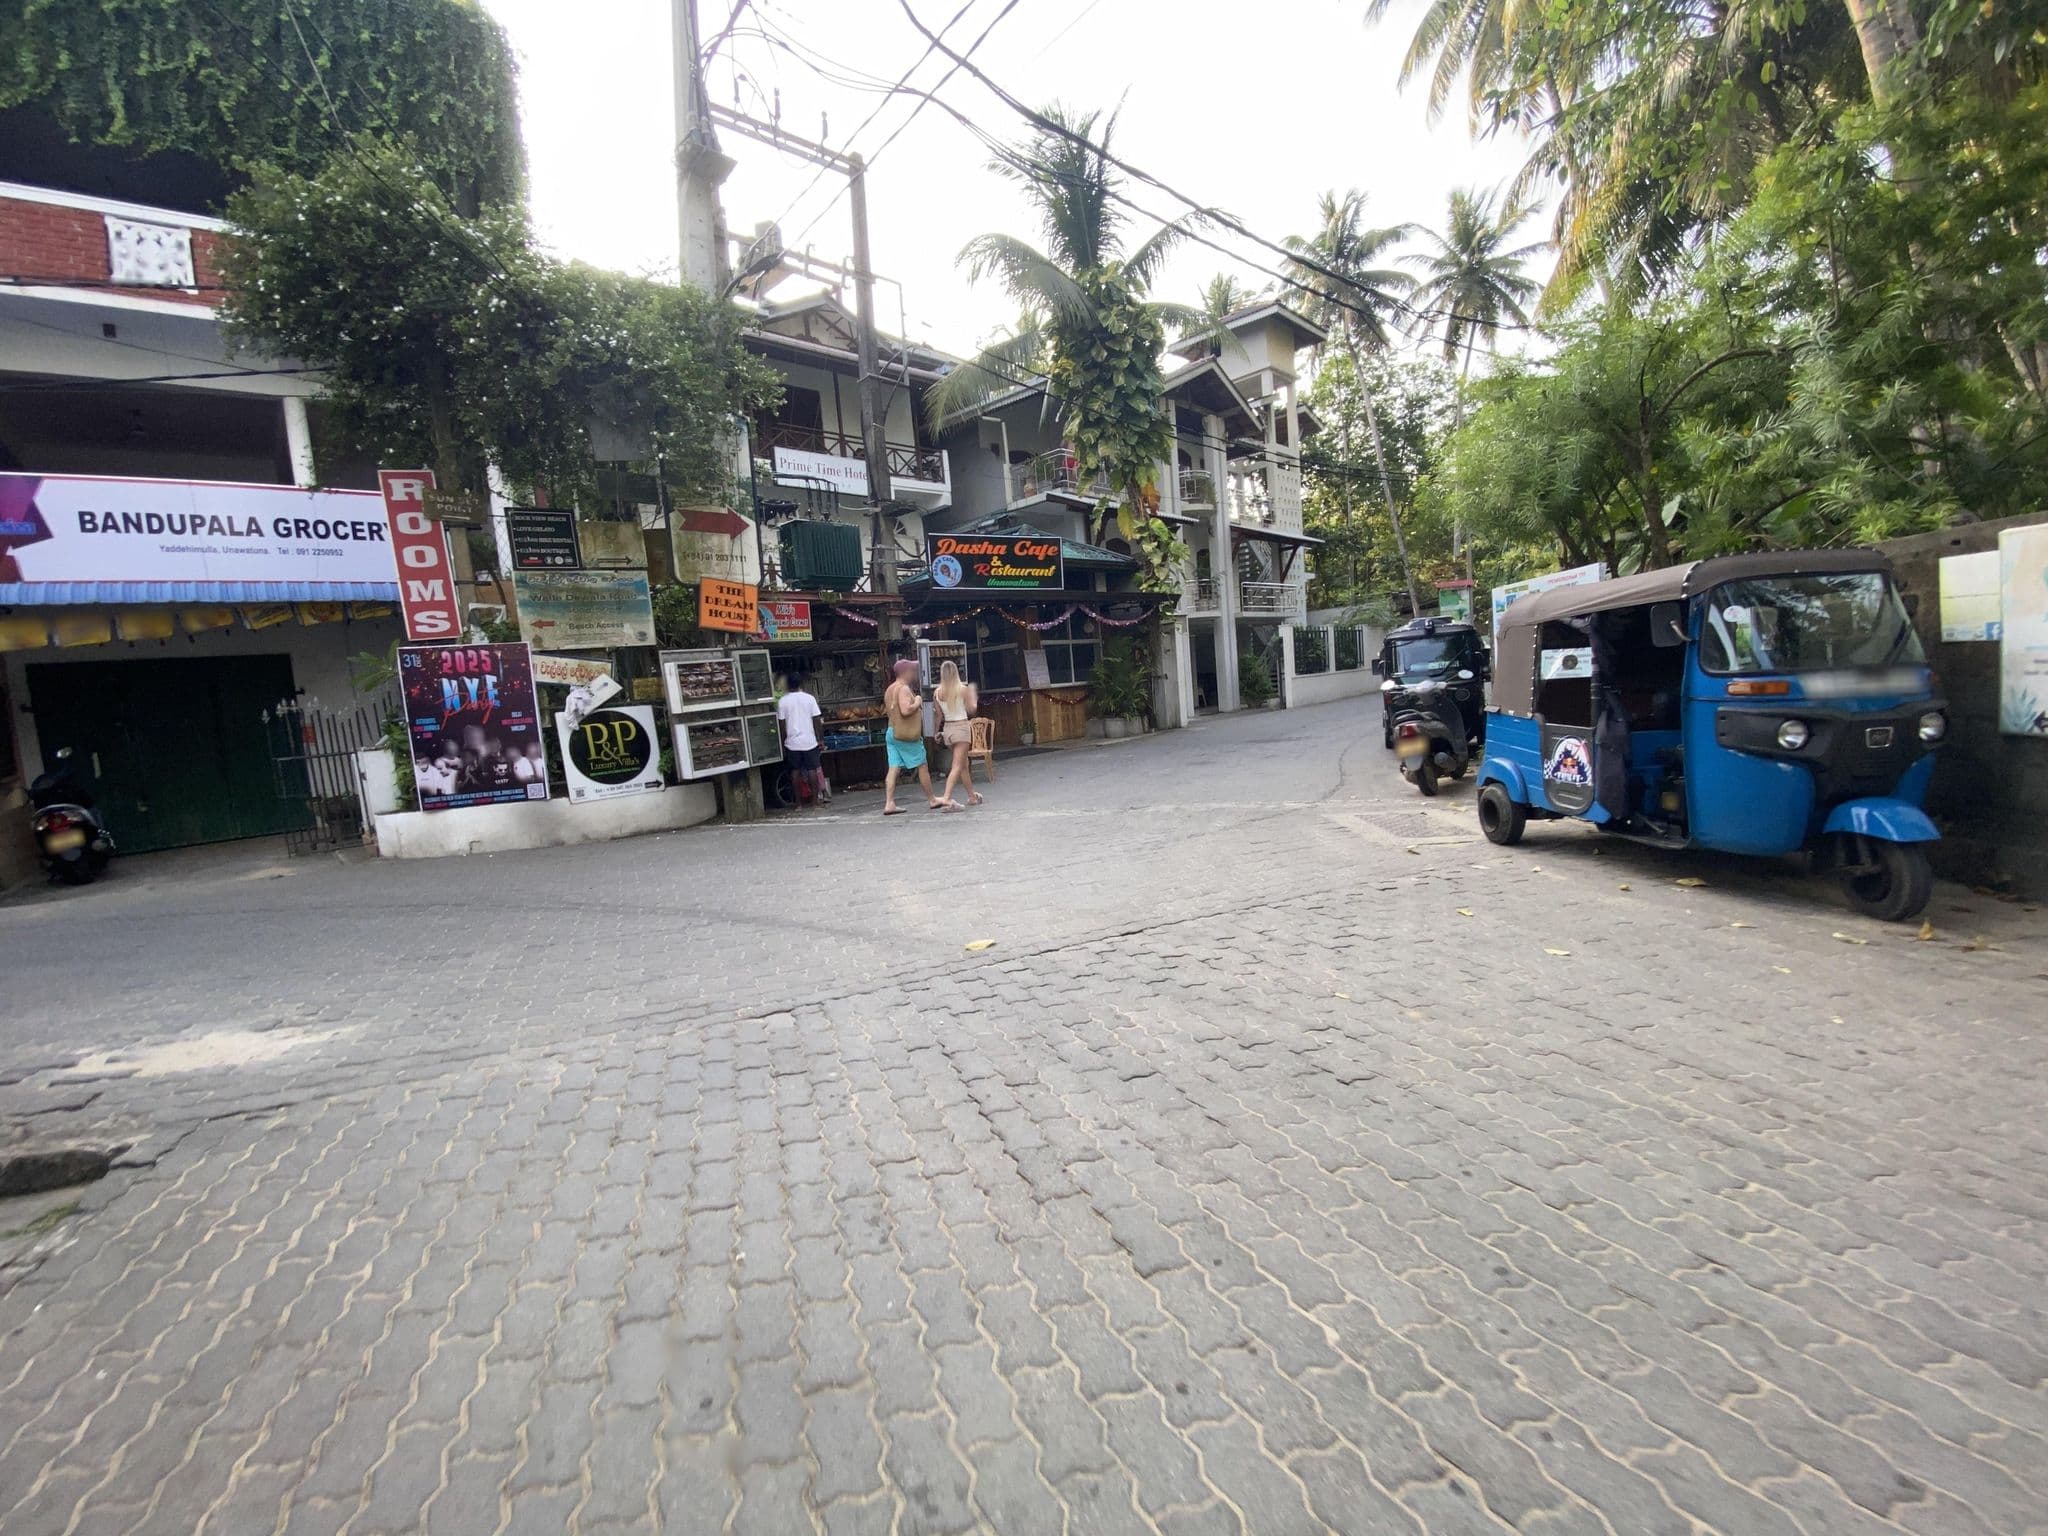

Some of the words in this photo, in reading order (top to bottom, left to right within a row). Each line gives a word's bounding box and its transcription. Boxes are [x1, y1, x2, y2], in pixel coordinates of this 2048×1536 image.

[779, 457, 812, 473] Prime
[815, 463, 841, 478] Time
[844, 467, 869, 481] Hote
[78, 510, 265, 537] BANDUPALA
[272, 518, 388, 542] GROCER
[387, 478, 451, 634] ROOMS
[935, 538, 1008, 556] Dasha
[1013, 540, 1059, 561] Cafe
[973, 562, 1057, 577] Restaurant
[990, 555, 1004, 567] &
[715, 584, 745, 598] THE
[704, 595, 754, 611] DREAM
[596, 620, 625, 629] Access
[708, 608, 751, 622] HOUSE
[402, 653, 417, 668] 31
[440, 649, 493, 674] 2025
[440, 674, 501, 712] NYE
[580, 720, 637, 761] P&P
